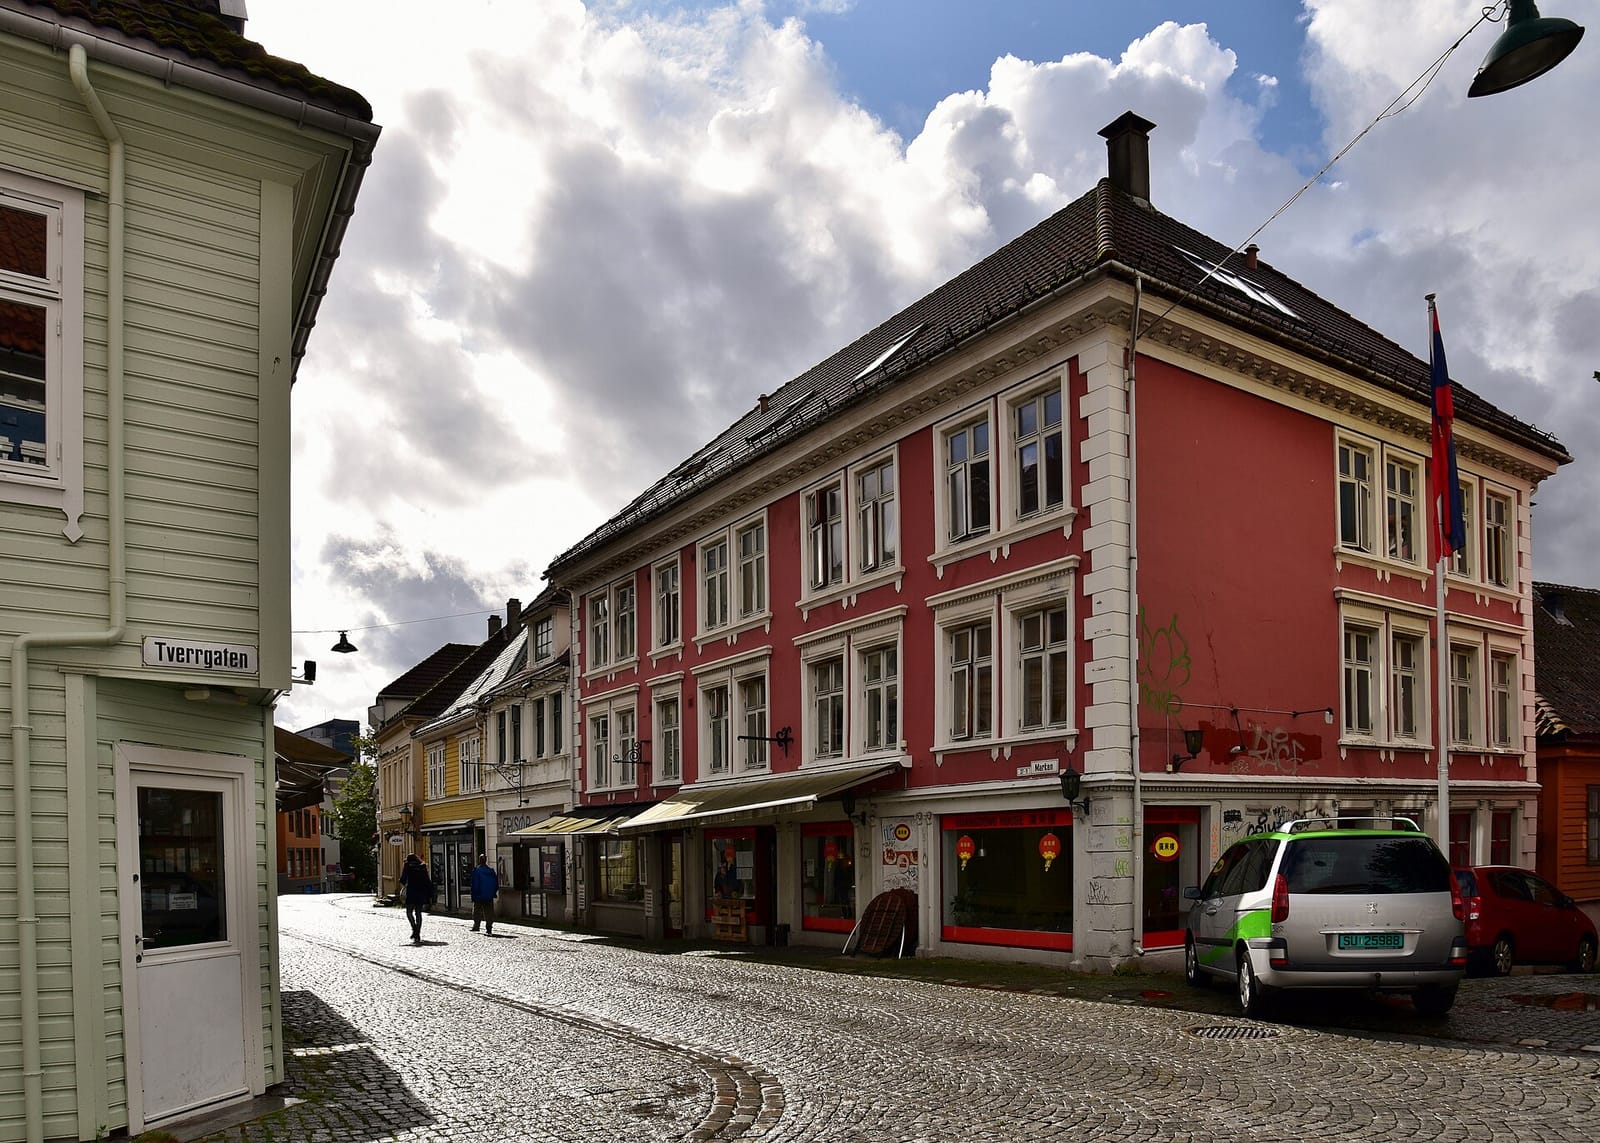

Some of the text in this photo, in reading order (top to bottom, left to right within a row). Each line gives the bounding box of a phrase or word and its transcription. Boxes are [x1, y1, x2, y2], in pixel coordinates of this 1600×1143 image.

[154, 641, 248, 669] Tverrgaten
[1034, 762, 1054, 772] Marken
[1343, 935, 1400, 946] SU 25988
